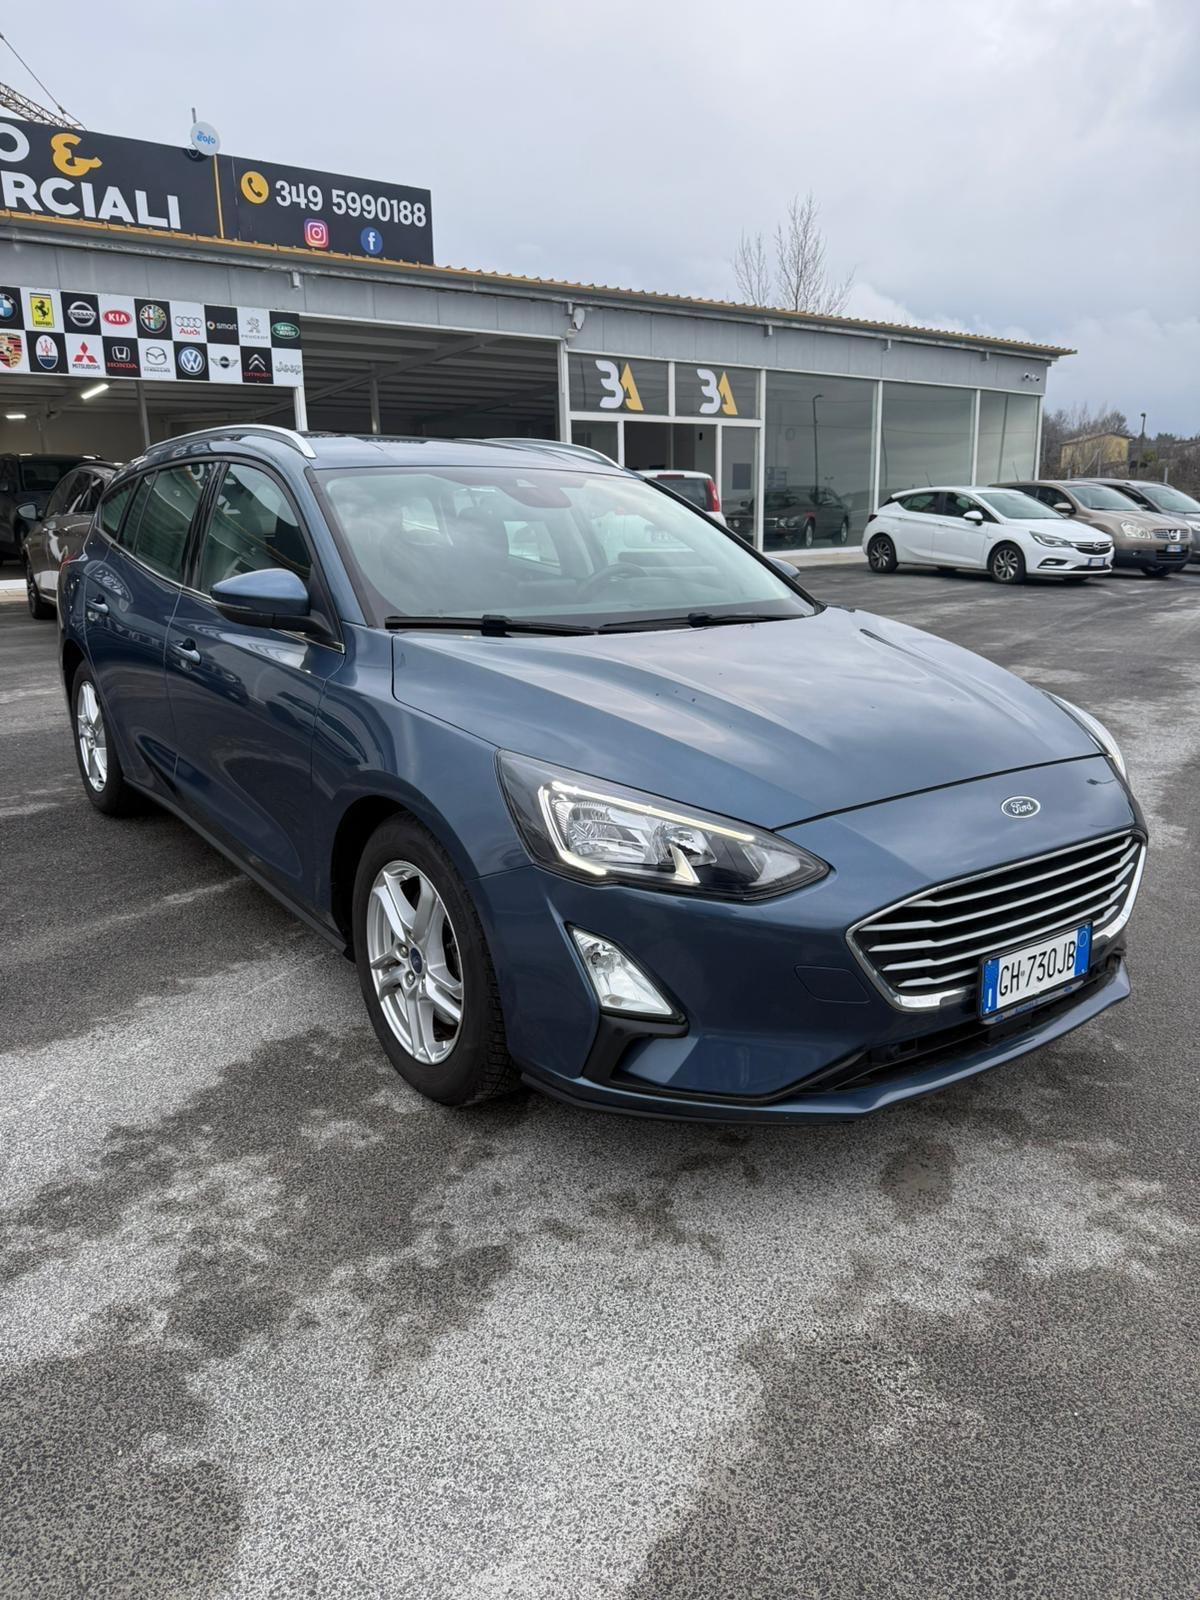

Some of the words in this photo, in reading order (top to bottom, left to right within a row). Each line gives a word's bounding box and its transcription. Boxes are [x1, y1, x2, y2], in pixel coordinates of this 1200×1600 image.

[51, 133, 103, 176] &
[0, 170, 181, 229] RCIALI
[275, 180, 323, 211] 349
[332, 189, 427, 227] 5990188
[108, 314, 128, 322] KIA
[179, 328, 201, 336] Audi
[216, 322, 238, 331] smart
[275, 361, 302, 375] Jeep
